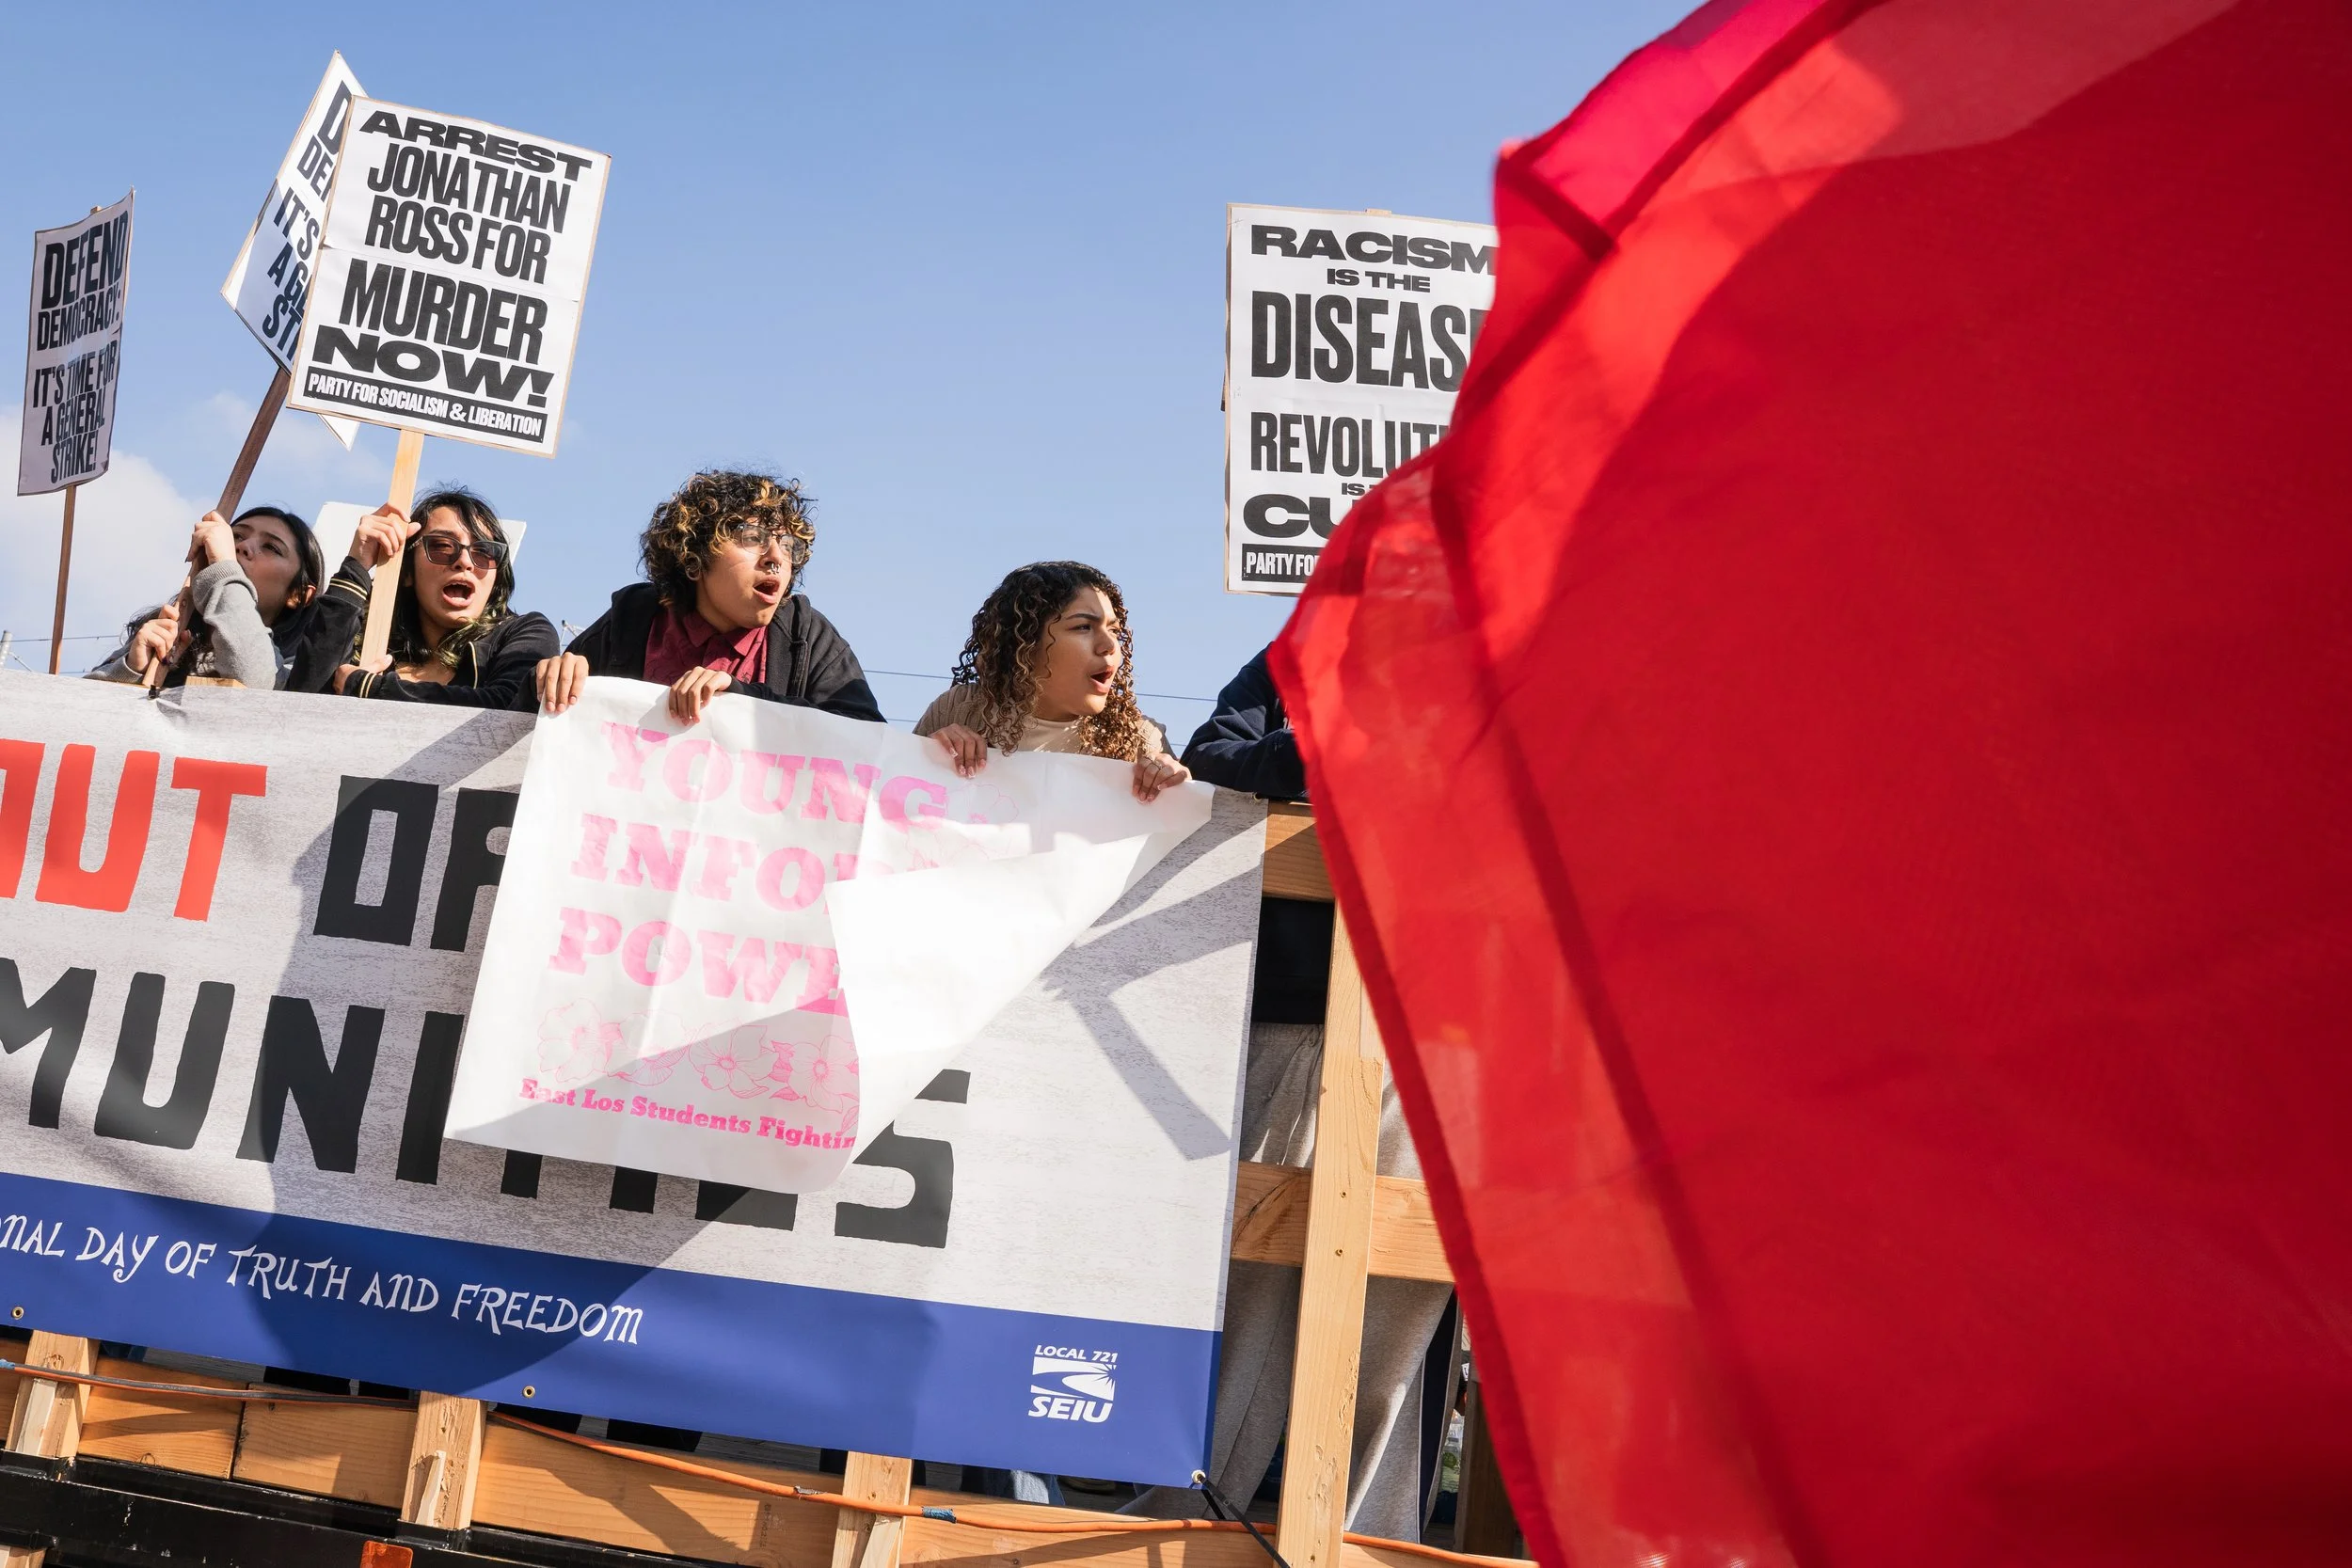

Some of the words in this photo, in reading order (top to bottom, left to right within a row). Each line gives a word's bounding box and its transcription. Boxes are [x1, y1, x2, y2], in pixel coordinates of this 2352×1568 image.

[358, 110, 593, 182] ARREST
[367, 143, 571, 233] JONATHAN
[273, 186, 320, 261] IT'S
[364, 194, 473, 265] ROSS
[472, 217, 551, 284] FOR
[1251, 224, 1498, 276] RACISM
[41, 210, 129, 309] DEFEND
[267, 242, 294, 288] A
[1327, 268, 1359, 286] IS
[1365, 271, 1430, 293] THE
[37, 289, 120, 351] DEMOCRACY:
[339, 258, 548, 365] MURDER
[33, 364, 65, 407] IT'S
[67, 351, 95, 401] TIME
[96, 341, 118, 389] FOR
[311, 325, 554, 408] NOW!
[41, 406, 53, 446] A
[56, 388, 105, 443] GENERAL
[308, 373, 351, 397] PARTY
[351, 382, 379, 404] FOR
[378, 387, 449, 419] SOCIALISM
[450, 403, 467, 422] &
[469, 406, 542, 436] LIBERATION
[51, 430, 99, 483] STRIKE!
[1250, 411, 1450, 478] REVOLUT
[1342, 483, 1364, 496] IS
[1246, 552, 1295, 576] PARTY
[600, 721, 947, 833] YOUNG
[519, 1078, 576, 1106] East
[581, 1088, 625, 1113] Los
[630, 1095, 751, 1134] Students
[75, 1227, 159, 1283] DAY
[166, 1241, 217, 1279] OF
[227, 1245, 352, 1300] TRUTH
[358, 1271, 439, 1313] AND
[451, 1283, 644, 1344] FREEDOM
[1035, 1344, 1087, 1360] LOCAL
[1091, 1351, 1119, 1363] 721
[1028, 1396, 1113, 1423] SEIU
